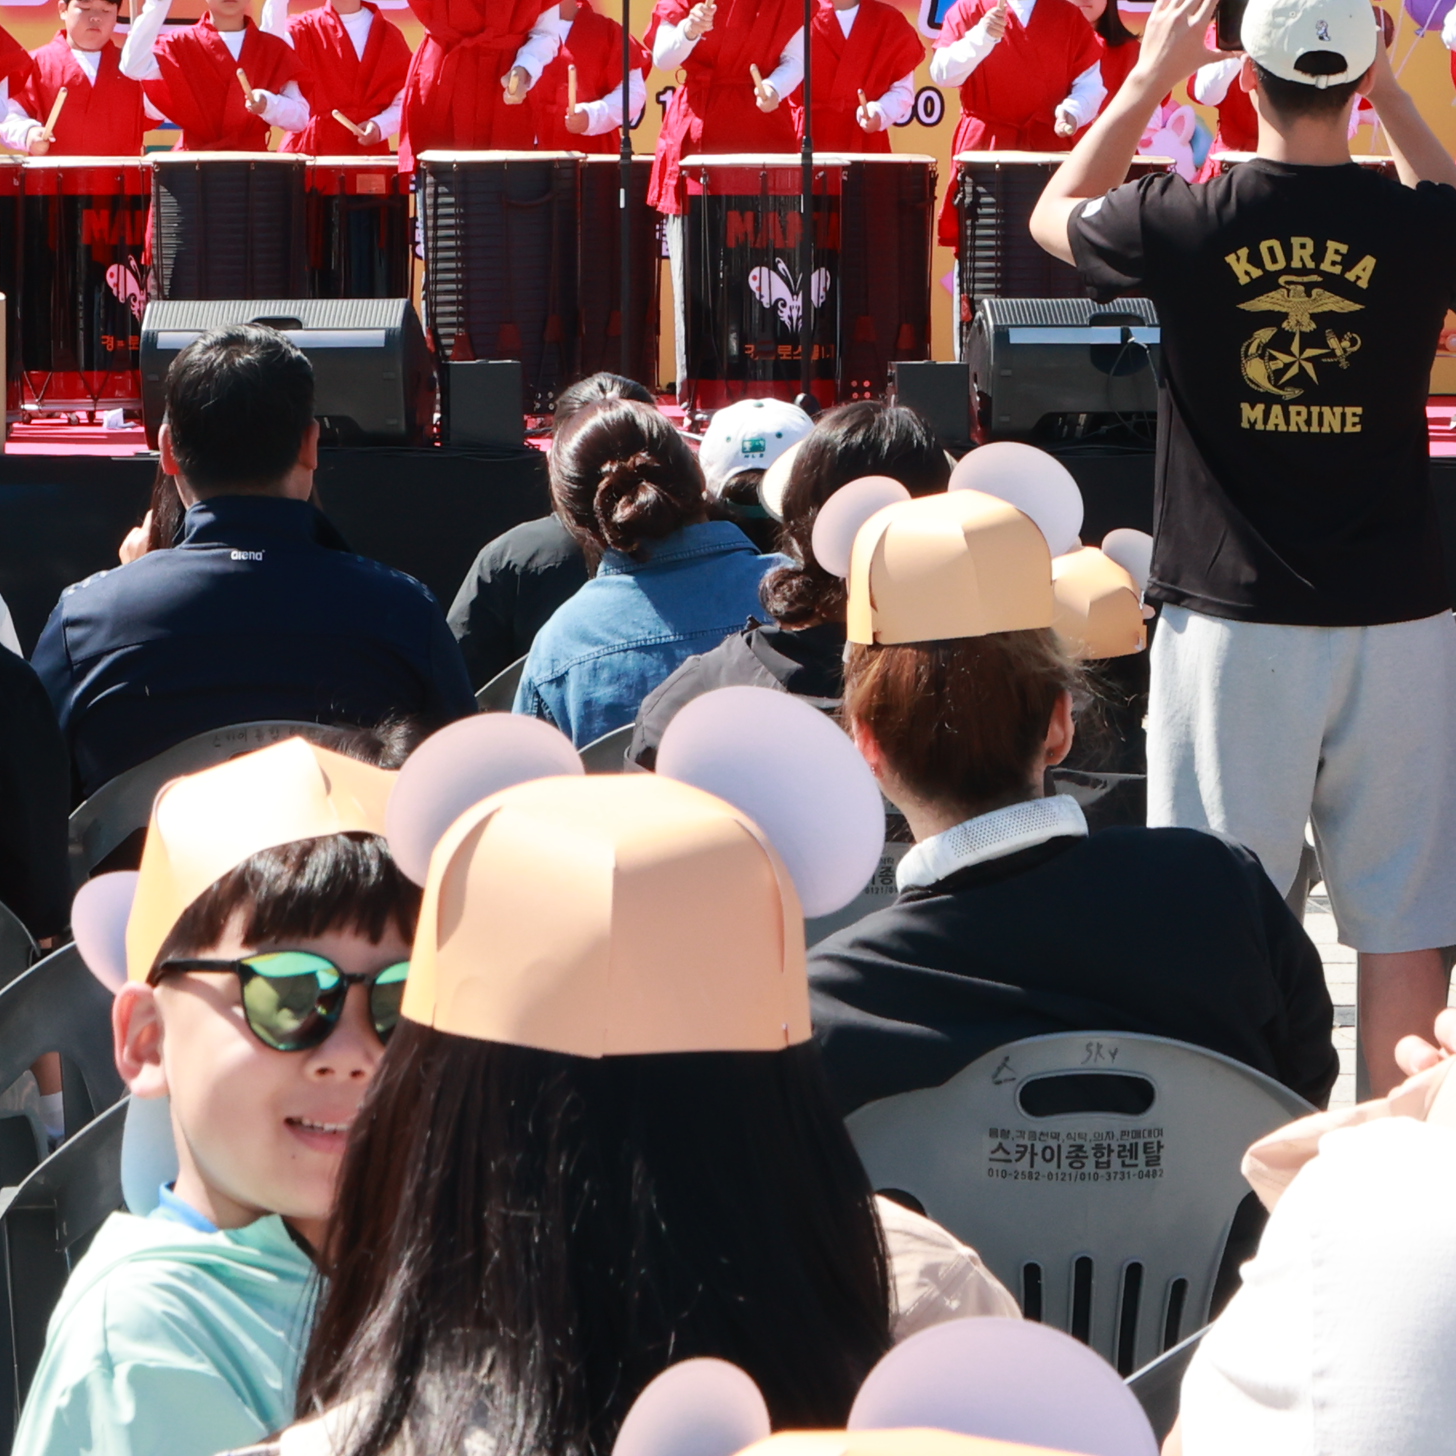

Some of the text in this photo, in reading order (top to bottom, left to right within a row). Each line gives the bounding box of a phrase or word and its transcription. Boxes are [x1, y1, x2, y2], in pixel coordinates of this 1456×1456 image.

[1224, 236, 1377, 290] KOREA
[1240, 402, 1363, 433] MARINE
[230, 549, 264, 561] arena
[1080, 1041, 1119, 1065] SKY
[988, 1140, 1165, 1170] 스카이종합렌탈
[987, 1167, 1164, 1183] 010-2582-0121/010-3731-0482
